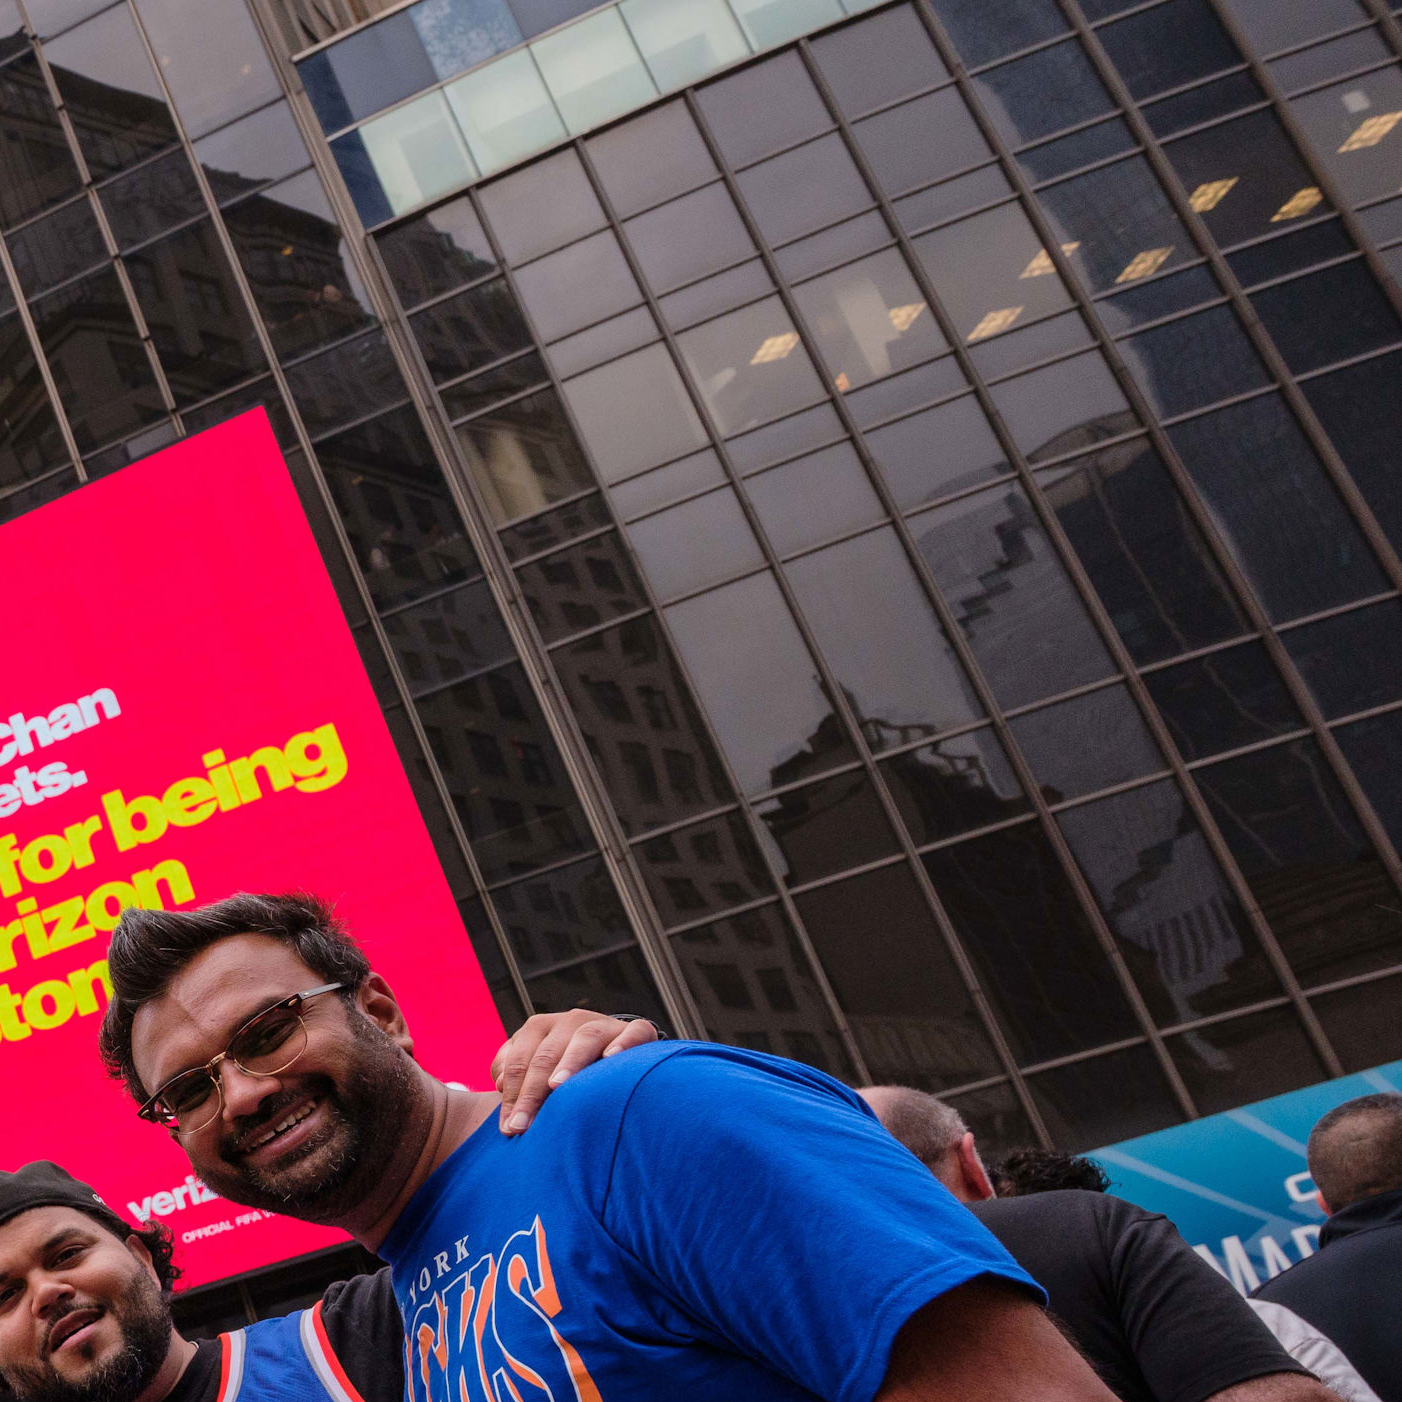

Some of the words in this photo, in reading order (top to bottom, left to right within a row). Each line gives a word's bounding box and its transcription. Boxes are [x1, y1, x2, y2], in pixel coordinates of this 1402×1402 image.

[102, 722, 348, 852] being
[127, 1175, 220, 1222] veriz
[182, 1220, 234, 1243] OFFICIAL
[236, 1210, 262, 1228] FIFA
